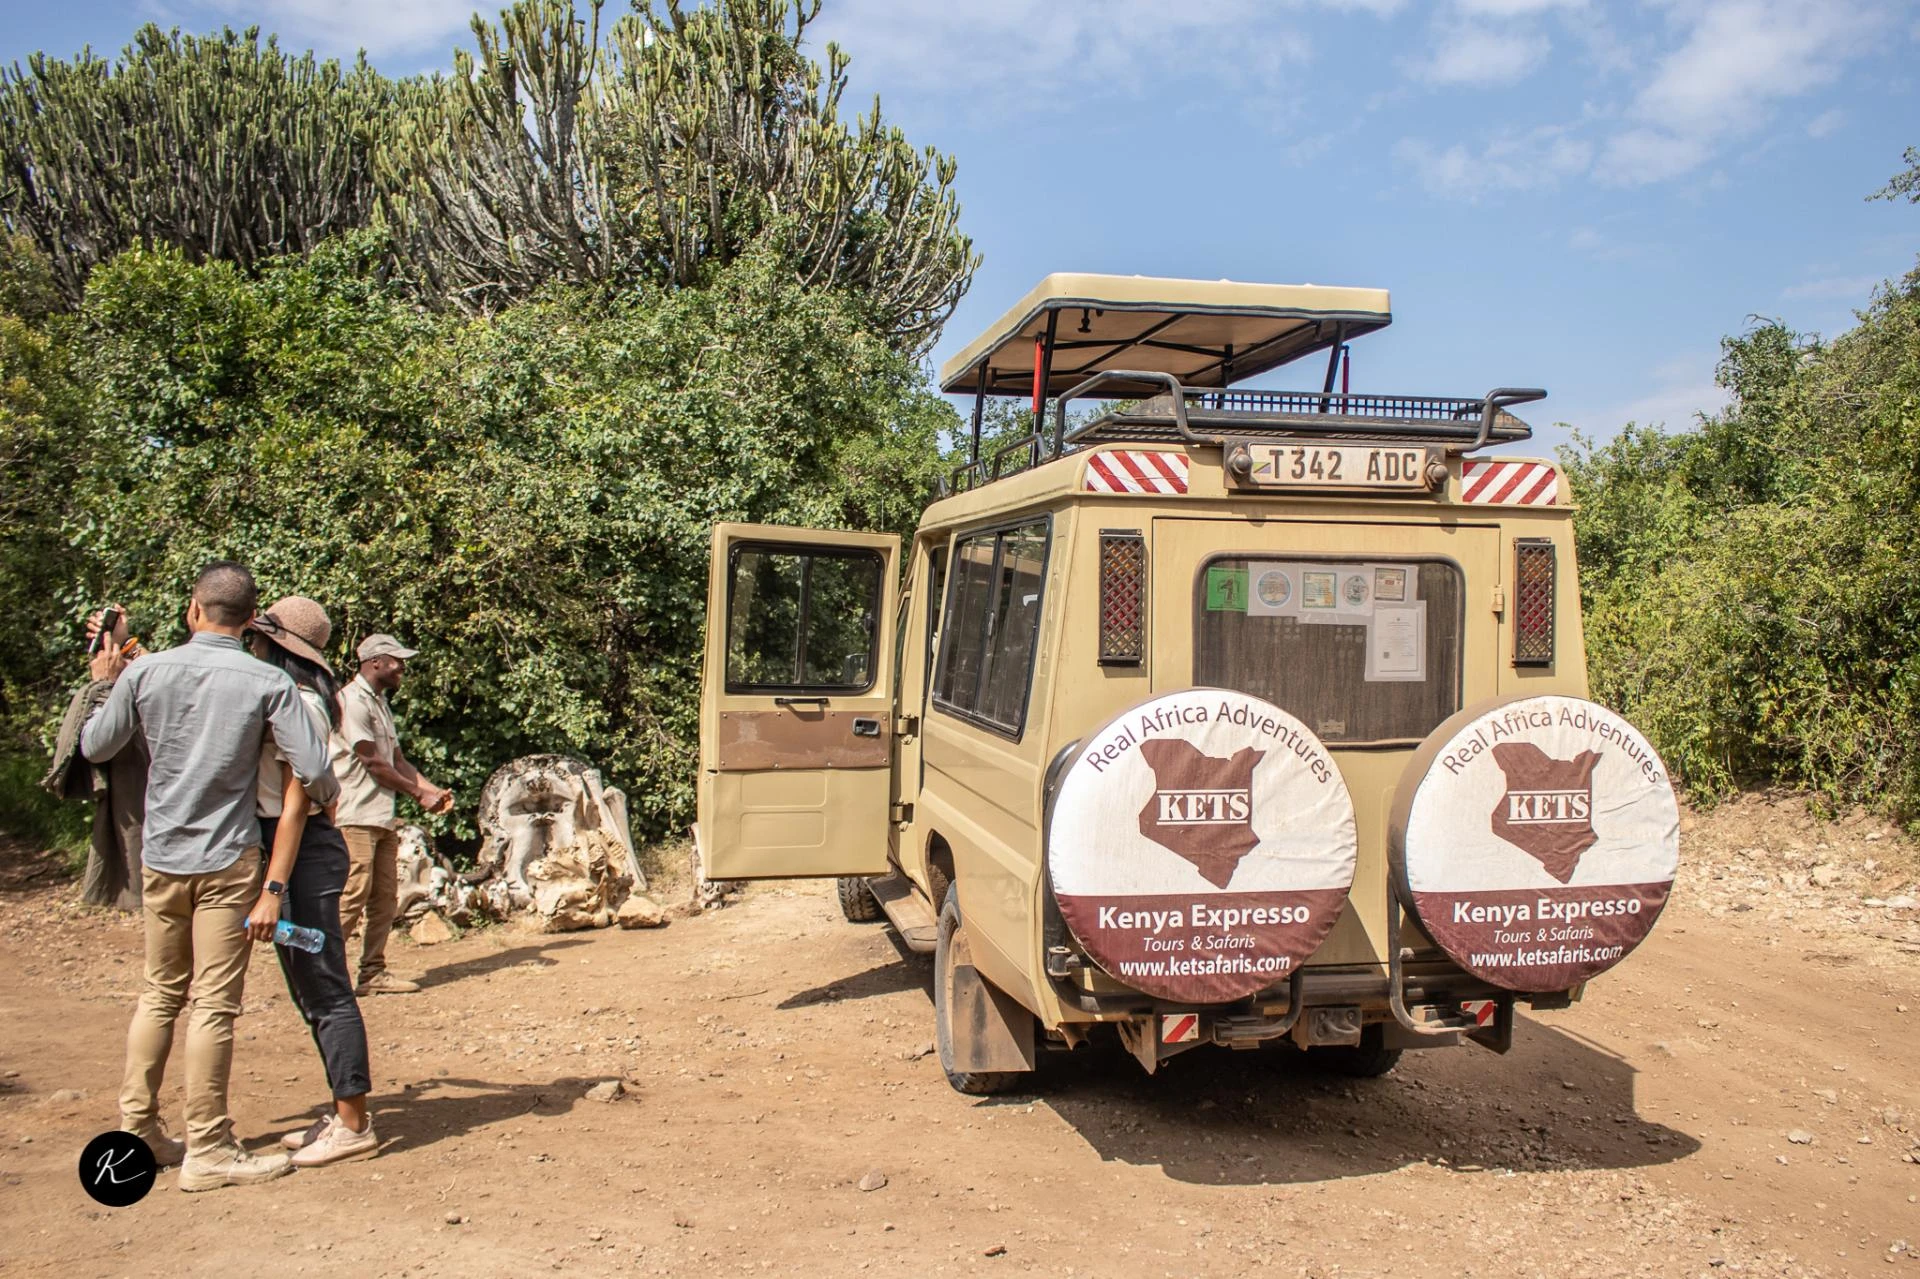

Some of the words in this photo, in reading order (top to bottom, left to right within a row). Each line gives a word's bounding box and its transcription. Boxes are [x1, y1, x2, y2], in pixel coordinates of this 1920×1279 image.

[1367, 452, 1417, 481] ADC
[1086, 724, 1136, 772] Real
[1141, 705, 1208, 737] Africa
[1216, 702, 1331, 784] Adventures
[1443, 732, 1488, 775] Real
[1492, 709, 1552, 742] Africa
[1559, 707, 1660, 784] Adventures
[1158, 794, 1249, 820] KETS
[1508, 794, 1589, 820] KETS
[1099, 907, 1183, 934] Kenya
[1191, 904, 1310, 931] Expresso
[1454, 902, 1530, 926] Kenya
[1537, 898, 1641, 923] Expresso
[1143, 937, 1184, 951] Tours
[1191, 937, 1202, 949] &
[1206, 934, 1255, 949] Safaris
[1494, 930, 1530, 943] Tours
[1537, 929, 1547, 941] &
[1549, 926, 1594, 941] Safaris
[1120, 954, 1290, 976] www.ketsafaris.com
[1472, 945, 1623, 967] www.ketsafaris.com
